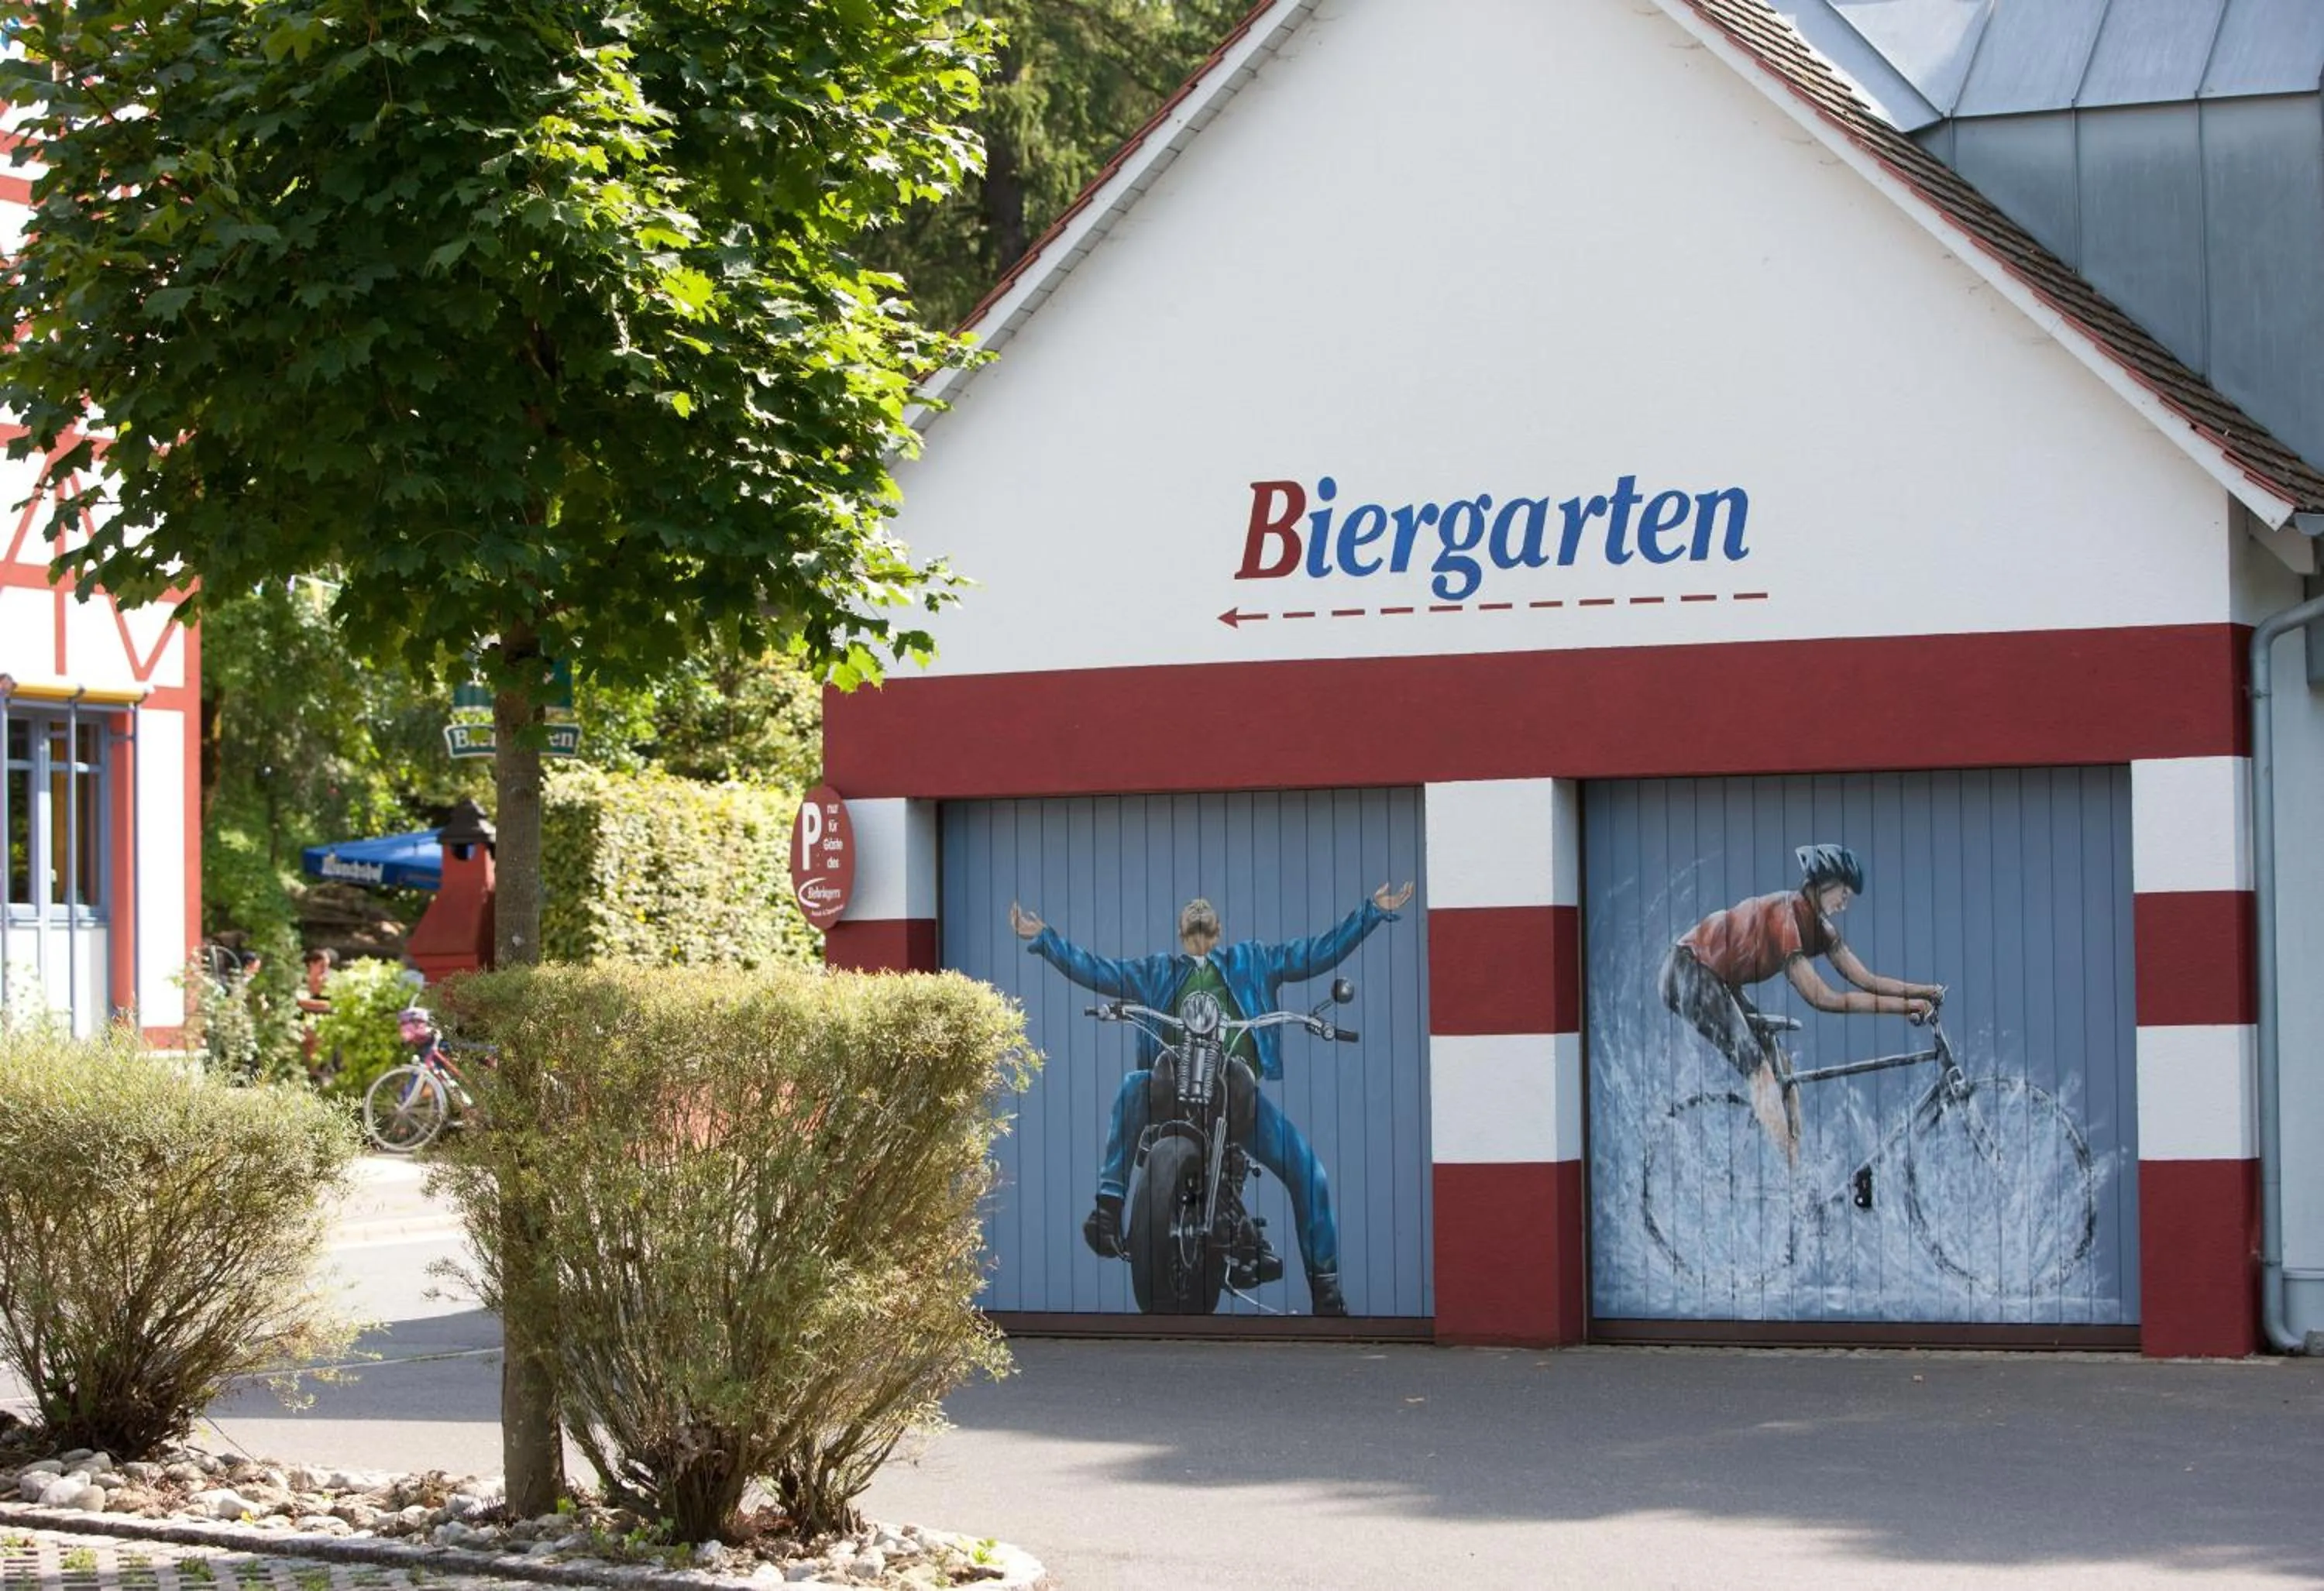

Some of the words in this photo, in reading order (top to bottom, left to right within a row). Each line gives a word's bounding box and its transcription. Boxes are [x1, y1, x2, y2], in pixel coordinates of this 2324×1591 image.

[1234, 474, 1750, 601] Biergarten
[802, 802, 822, 871] P
[828, 820, 838, 833] für
